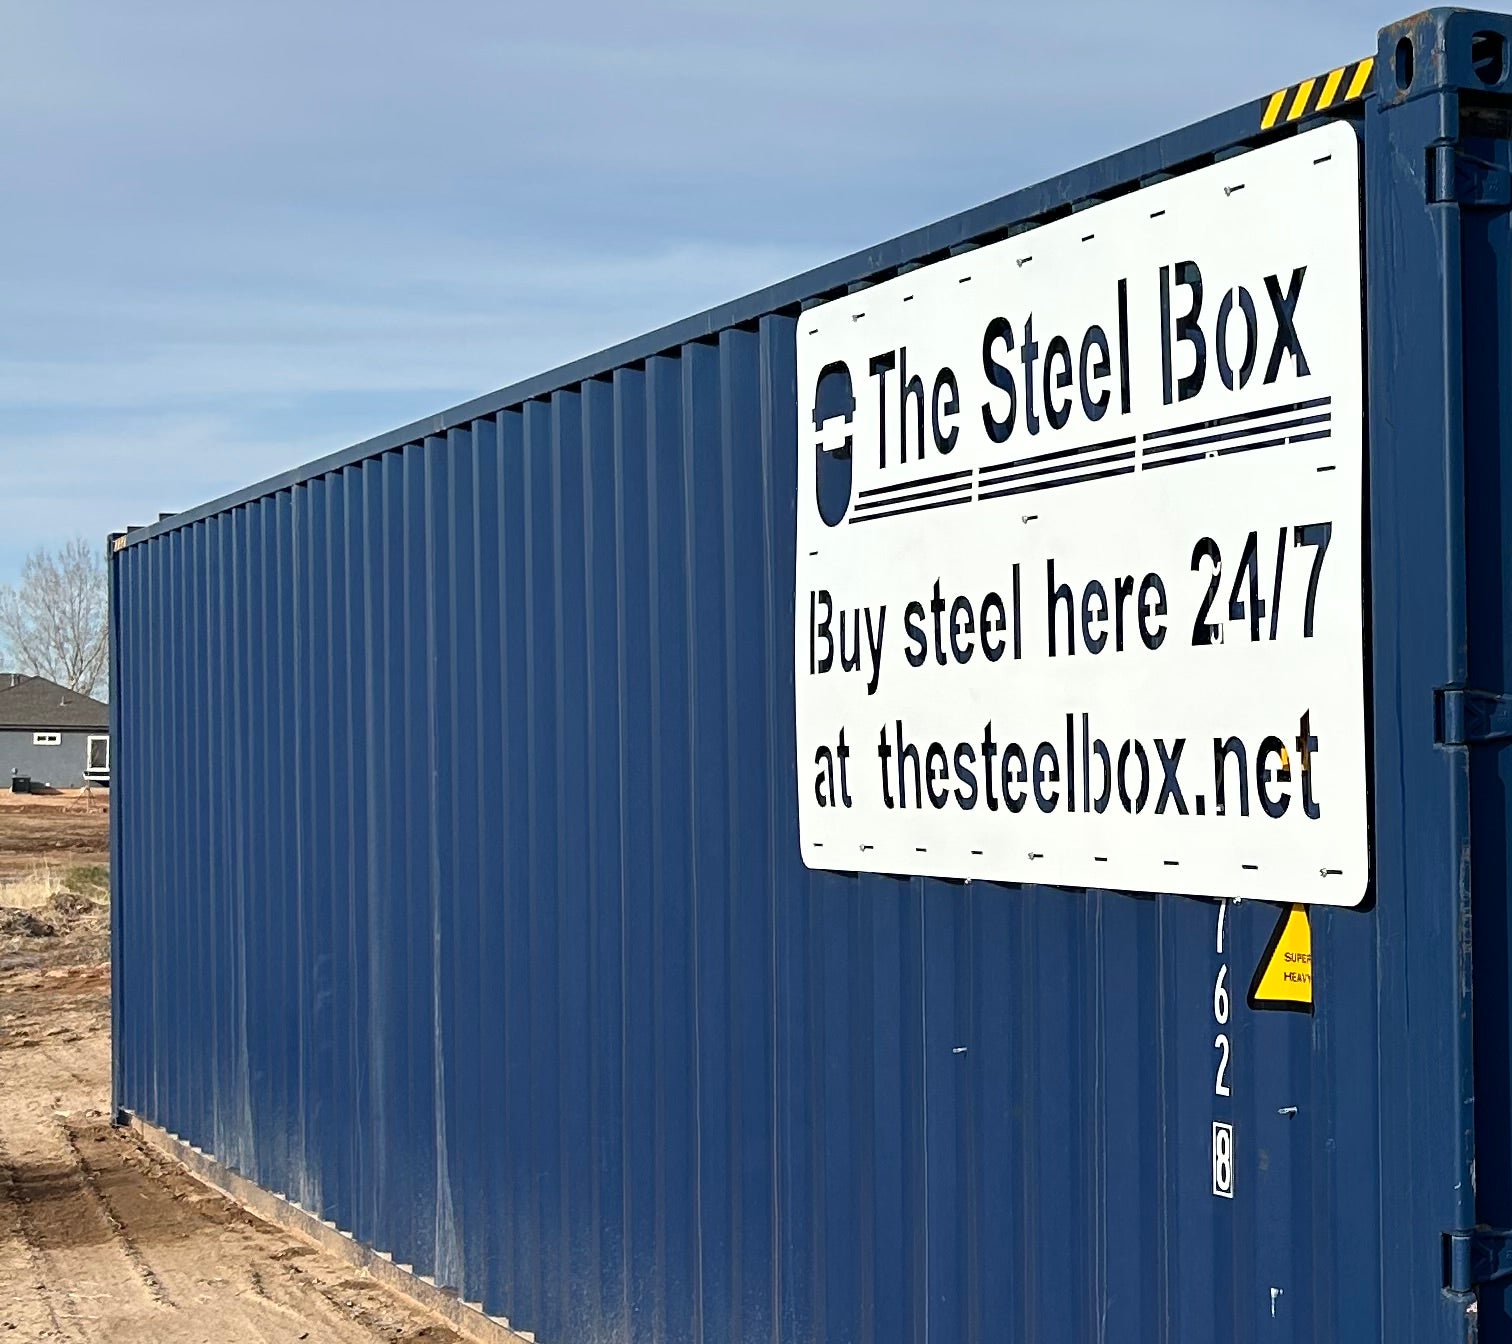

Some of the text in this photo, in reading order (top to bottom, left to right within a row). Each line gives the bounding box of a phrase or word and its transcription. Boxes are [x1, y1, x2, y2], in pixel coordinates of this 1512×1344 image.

[869, 260, 1310, 469] The Steel Box
[809, 521, 1333, 695] Buy steel here 24/7
[814, 709, 1320, 820] at thesteelbox.net
[1214, 1126, 1232, 1194] 8
